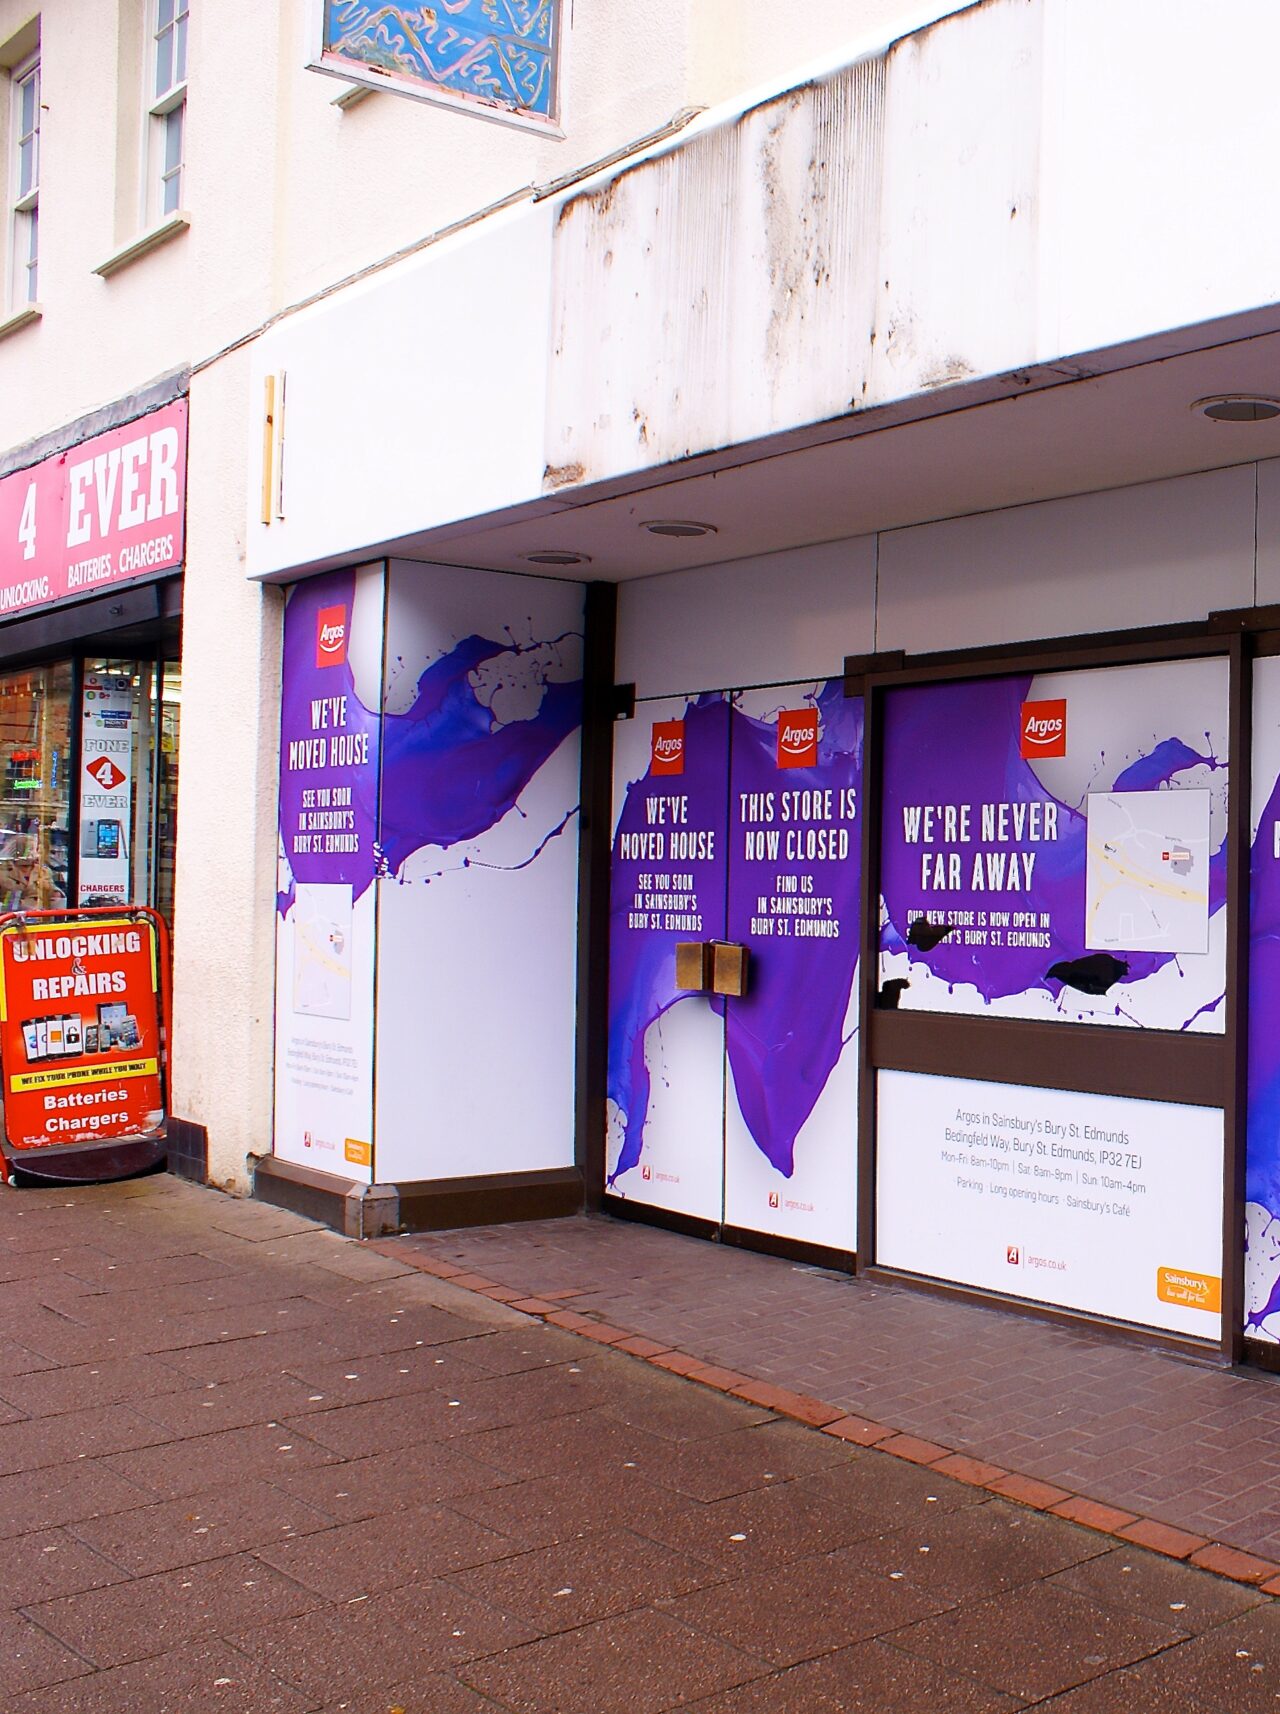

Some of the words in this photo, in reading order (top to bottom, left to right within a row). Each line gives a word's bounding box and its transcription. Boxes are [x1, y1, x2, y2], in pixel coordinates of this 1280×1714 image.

[18, 482, 37, 560] 4
[67, 426, 179, 548] EVER
[68, 553, 111, 588] BATTERIES
[119, 534, 174, 572] CHARGERS
[319, 623, 344, 644] Argos
[311, 696, 347, 730] WE'VE
[781, 726, 814, 747] Argos
[1025, 716, 1062, 738] Argos
[85, 738, 129, 752] FONE
[289, 738, 326, 770] MOVED
[331, 733, 369, 767] HOUSE
[654, 736, 682, 755] Argos
[96, 762, 113, 785] 4
[83, 794, 129, 808] EVER
[303, 789, 315, 808] SEE
[317, 788, 331, 807] YOU
[332, 787, 351, 806] SOON
[740, 792, 775, 823] THIS
[781, 789, 833, 822] STORE
[839, 788, 856, 820] IS
[299, 813, 307, 830] IN
[308, 810, 354, 831] SAINSBURY'S
[646, 796, 688, 825] WE'VE
[903, 804, 971, 844] WE'RE
[981, 802, 1058, 843] NEVER
[294, 835, 311, 854] BURY
[313, 835, 324, 853] ST.
[325, 834, 359, 853] EDMUNDS
[620, 832, 664, 860] MOVED
[670, 831, 715, 861] HOUSE
[745, 831, 780, 861] NOW
[786, 829, 848, 861] CLOSED
[638, 873, 653, 890] SEE
[654, 874, 670, 890] YOU
[672, 874, 693, 891] SOON
[922, 853, 962, 891] FAR
[971, 852, 1036, 892] AWAY
[80, 884, 125, 892] CHARGERS
[776, 875, 798, 893] FIND
[800, 875, 813, 894] US
[634, 893, 642, 910] IN
[644, 893, 697, 911] SAINSBURY'S
[757, 896, 768, 914] IN
[770, 896, 833, 916] SAINSBURY'S
[629, 913, 649, 929] BURY
[650, 914, 663, 930] ST.
[664, 914, 703, 932] EDMUNDS
[750, 917, 775, 936] BURY
[777, 918, 792, 936] ST.
[794, 919, 840, 938] EDMUNDS
[926, 910, 945, 925] NEW
[947, 911, 974, 926] STORE
[977, 912, 986, 927] IS
[990, 912, 1010, 927] NOW
[1013, 912, 1035, 928] OPEN
[1039, 913, 1050, 929] IN
[12, 931, 141, 963] UNLOCKING
[965, 930, 988, 946] BURY
[990, 931, 1004, 946] ST.
[1007, 932, 1051, 949] EDMUNDS
[71, 957, 87, 975] &
[32, 970, 127, 1001] REPAIRS
[43, 1089, 128, 1110] Batteries
[45, 1111, 129, 1132] Chargers
[955, 1108, 981, 1126] Argos
[982, 1112, 990, 1126] in
[992, 1113, 1043, 1135] Sainsbury's
[1044, 1120, 1067, 1139] Bury
[1084, 1125, 1129, 1145] Edmunds
[1013, 1137, 1034, 1156] Bury
[1051, 1143, 1097, 1165] Edmunds,
[1099, 1150, 1123, 1167] IP32
[1125, 1154, 1142, 1170] 7EJ
[1164, 1272, 1208, 1292] Sainsbury's
